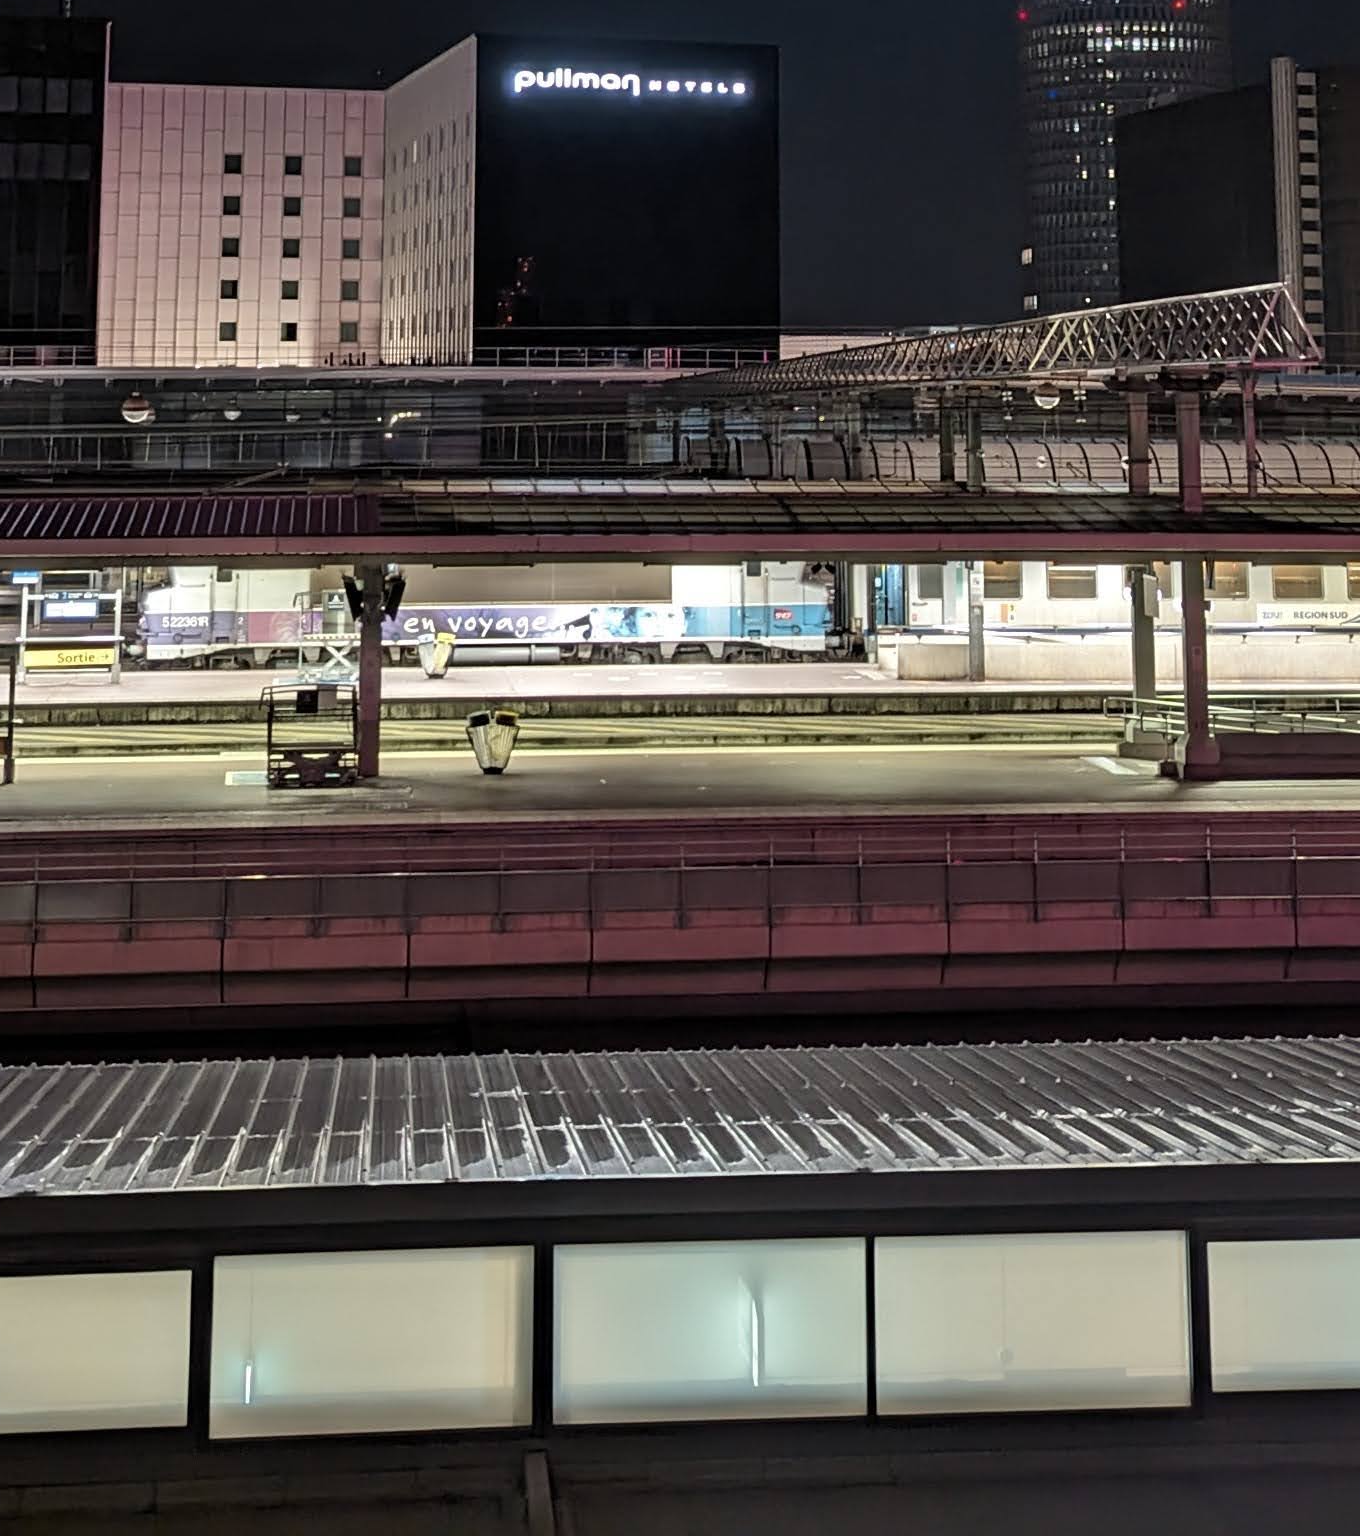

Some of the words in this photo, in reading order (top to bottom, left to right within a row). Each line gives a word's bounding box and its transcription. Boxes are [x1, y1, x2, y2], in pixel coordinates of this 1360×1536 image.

[514, 67, 641, 96] pullman
[649, 79, 746, 95] HOTELS
[1330, 611, 1348, 619] SUD
[162, 616, 209, 628] 522361R
[403, 617, 436, 632] en
[57, 652, 96, 664] Sortie
